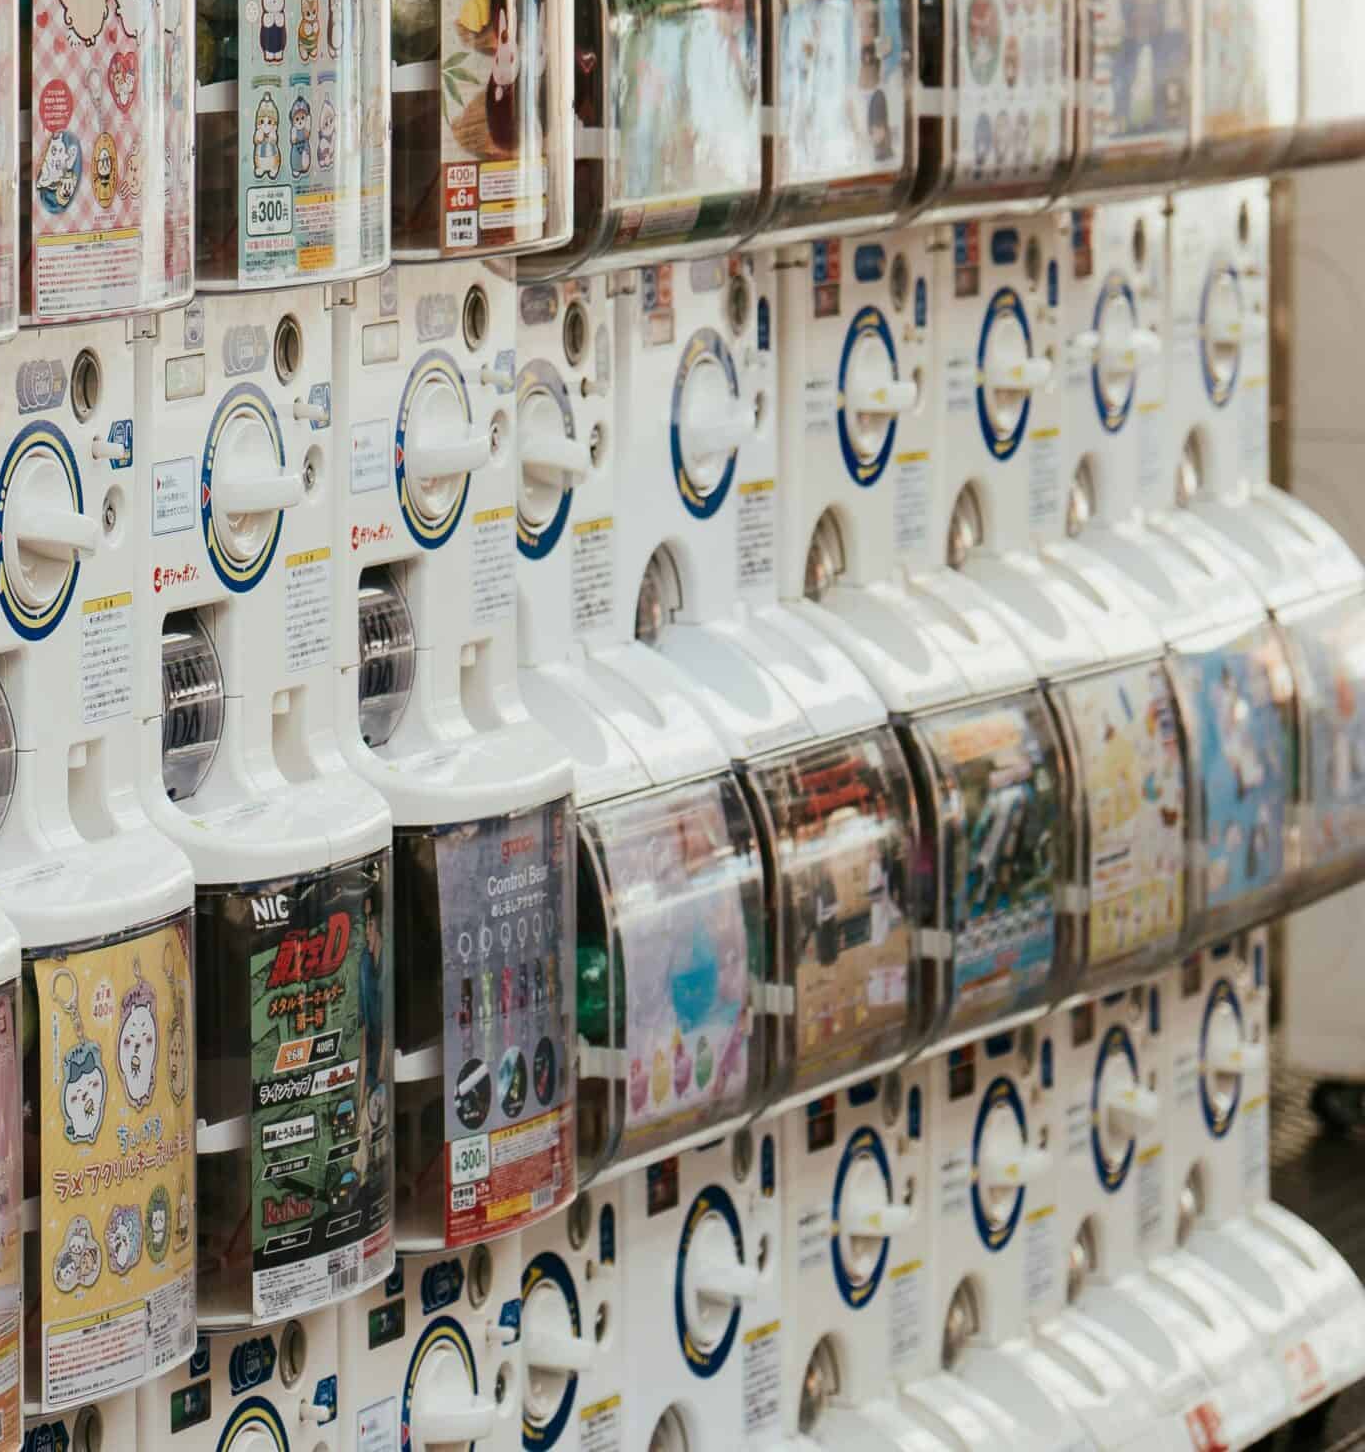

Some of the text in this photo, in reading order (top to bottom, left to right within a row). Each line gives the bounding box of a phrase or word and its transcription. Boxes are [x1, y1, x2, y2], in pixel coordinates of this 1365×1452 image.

[360, 524, 393, 545] ガシャポン
[162, 563, 199, 588] ガシャポン
[487, 867, 527, 897] Control
[251, 893, 290, 922] NIC
[259, 1073, 312, 1106] ラインナップ
